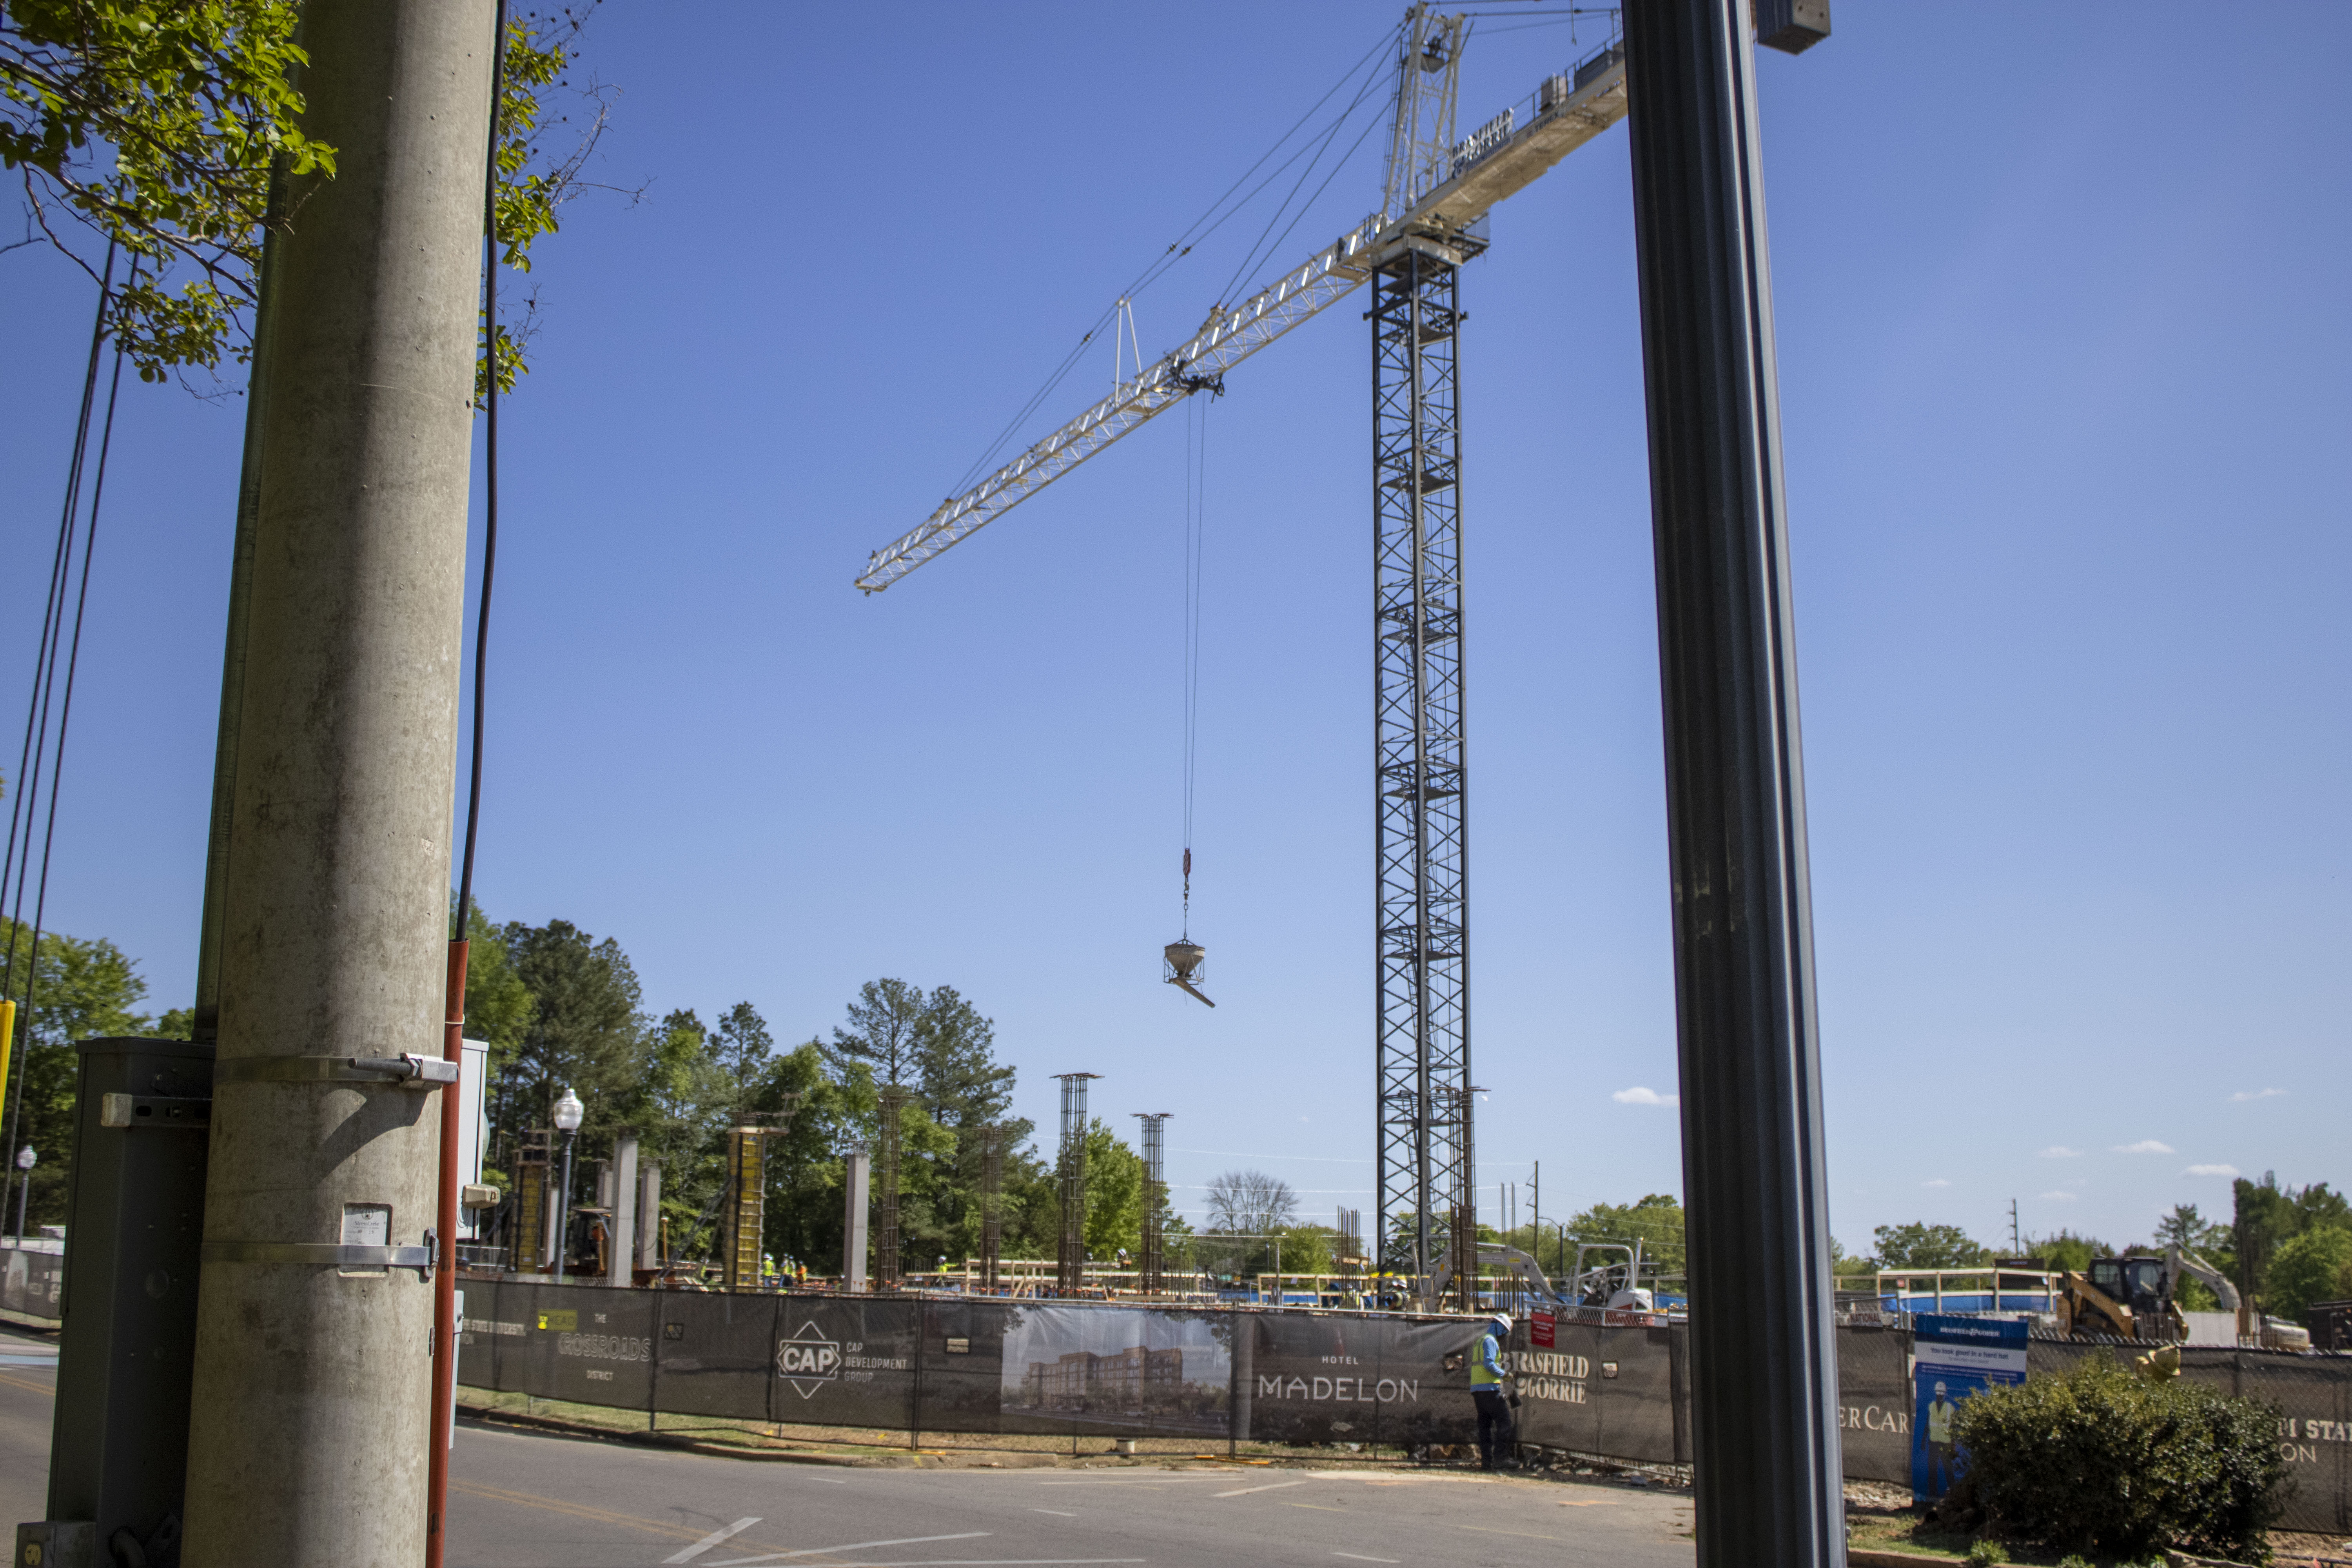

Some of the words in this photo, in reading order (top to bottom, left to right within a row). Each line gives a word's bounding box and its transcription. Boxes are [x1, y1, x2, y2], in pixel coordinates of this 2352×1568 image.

[594, 1313, 606, 1323] THE
[558, 1332, 651, 1362] CROSSROADS
[847, 1342, 862, 1352] CAP
[784, 1347, 834, 1372] CAP
[846, 1357, 907, 1370] DEVELOPMENT
[1322, 1356, 1359, 1365] HOTEL
[845, 1371, 874, 1383] GROUP
[1259, 1375, 1418, 1403] MADELON
[1838, 1405, 1910, 1434] ERCAR
[2279, 1443, 2317, 1463] ON
